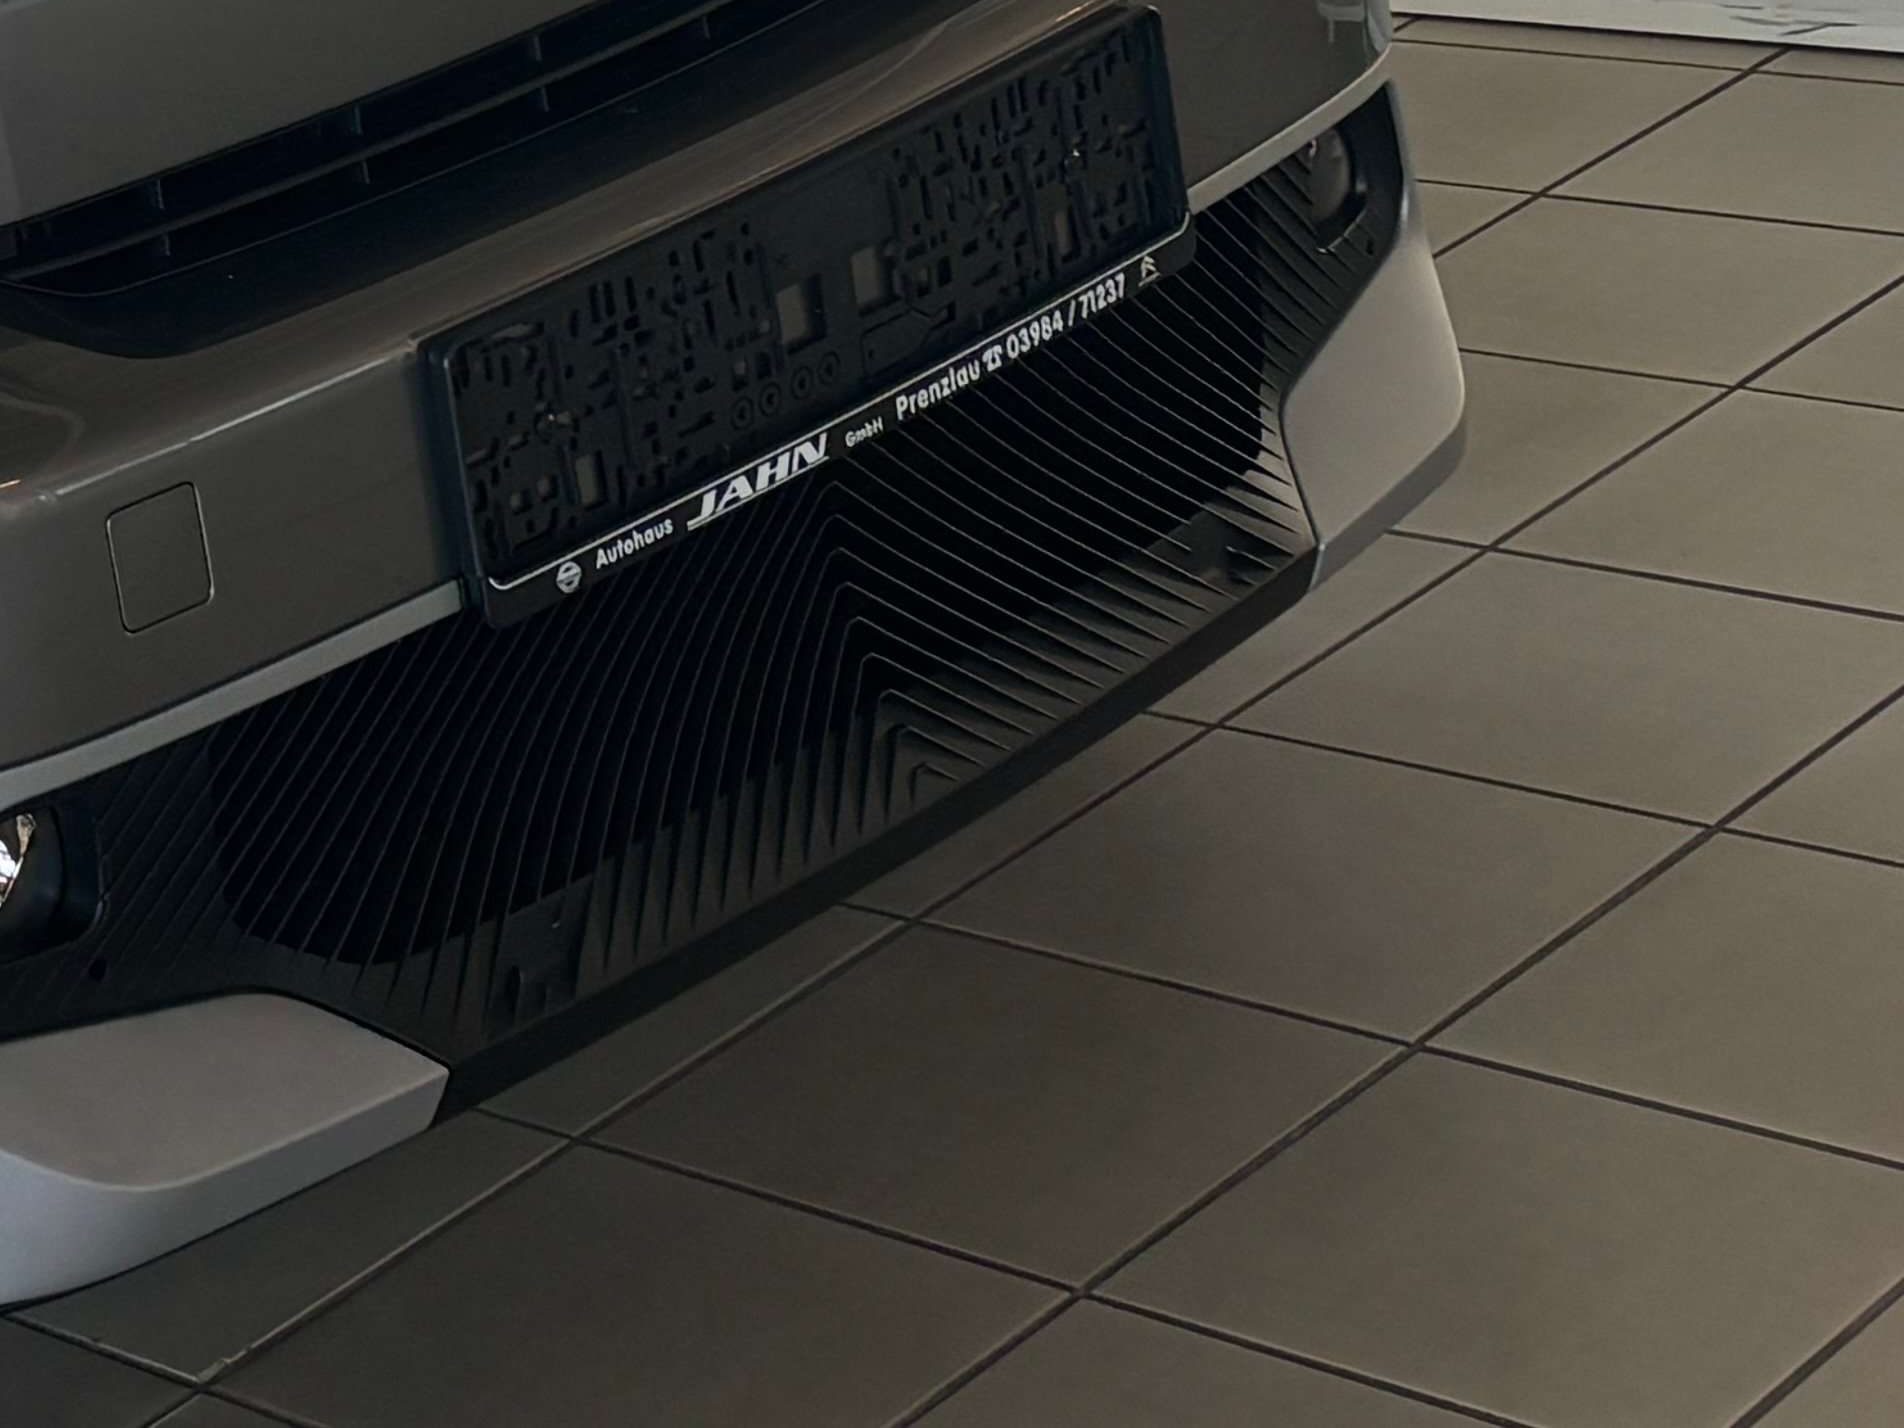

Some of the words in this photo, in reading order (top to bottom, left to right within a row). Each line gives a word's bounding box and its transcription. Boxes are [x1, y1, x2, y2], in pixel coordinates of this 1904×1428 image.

[596, 518, 674, 570] Autohaus
[686, 433, 830, 531] JAHN
[844, 416, 884, 448] GmbH
[895, 358, 980, 421] Prenzlau
[1005, 309, 1065, 359] 03984
[1078, 273, 1126, 319] 71237
